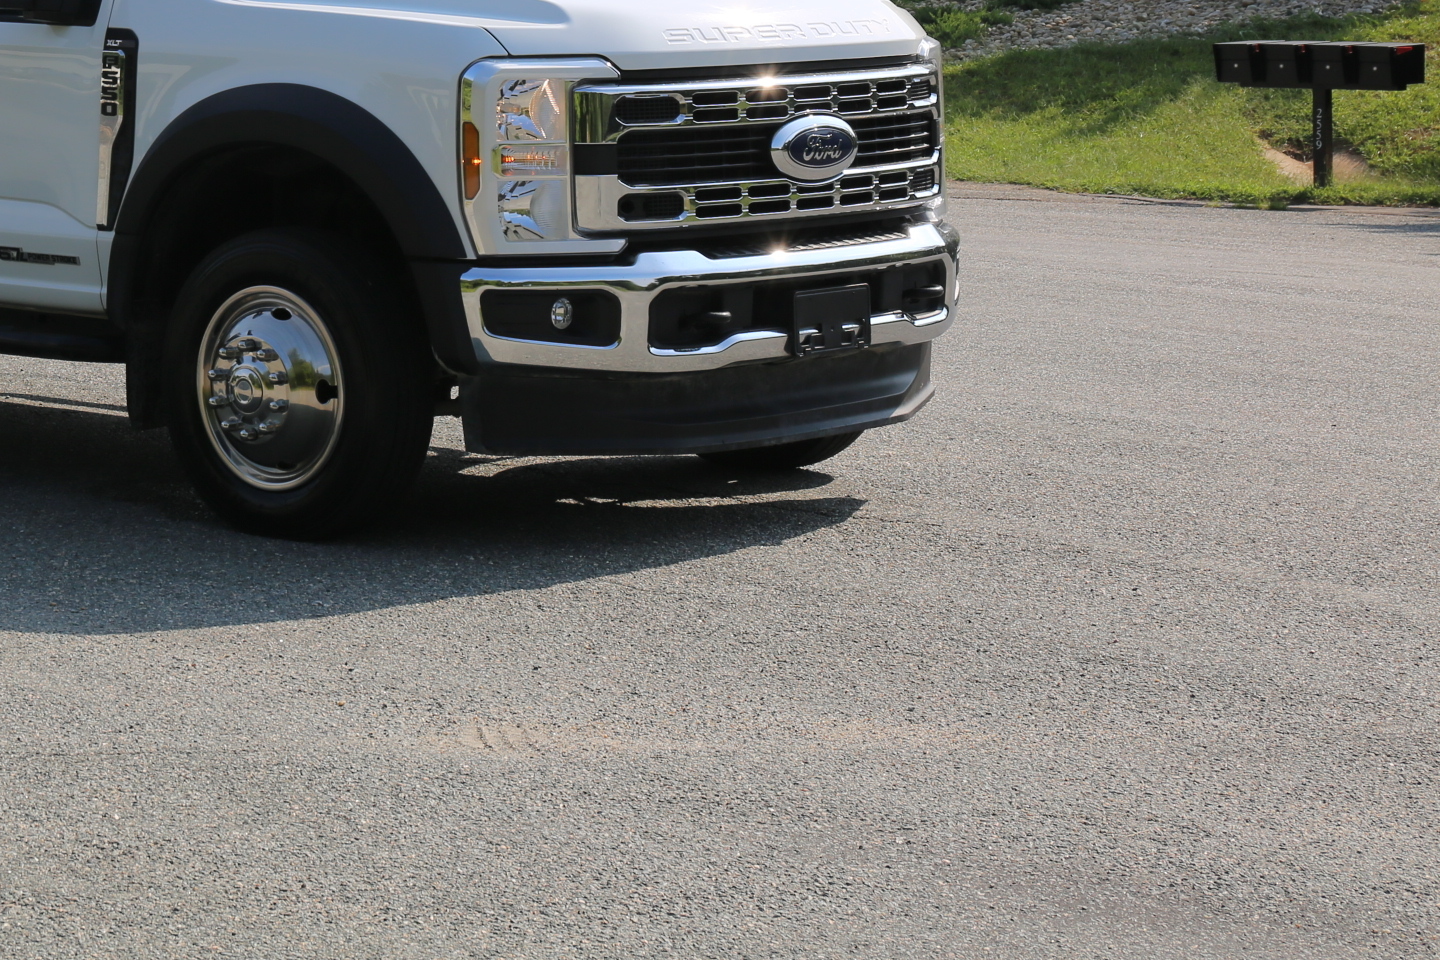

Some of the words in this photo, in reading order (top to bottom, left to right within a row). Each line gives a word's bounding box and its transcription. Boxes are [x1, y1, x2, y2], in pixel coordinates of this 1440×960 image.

[106, 39, 123, 47] XLT
[661, 23, 808, 45] SUPER
[807, 18, 892, 39] DUTY
[1315, 108, 1323, 150] 2559
[803, 133, 843, 161] Ford
